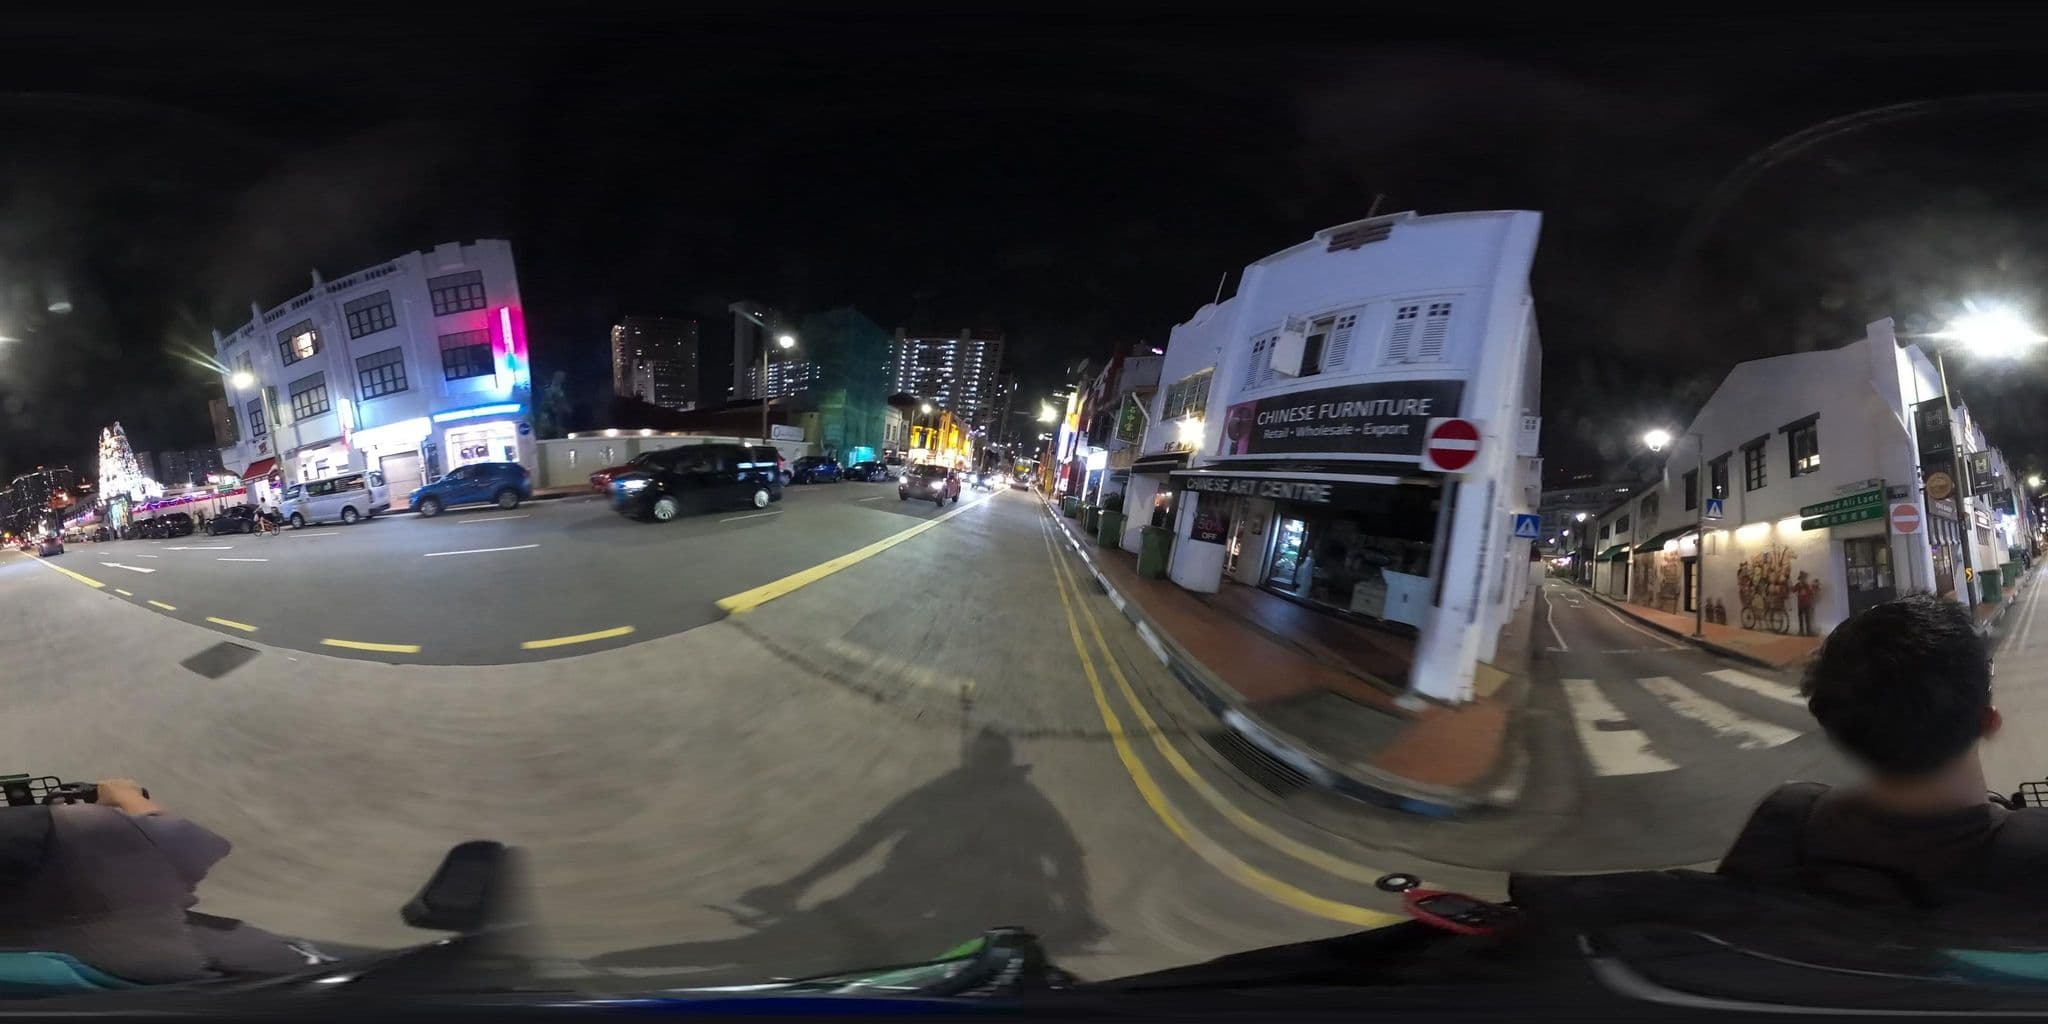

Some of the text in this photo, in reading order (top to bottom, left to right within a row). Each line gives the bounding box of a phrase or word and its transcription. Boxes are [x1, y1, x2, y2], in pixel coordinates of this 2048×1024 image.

[1257, 398, 1432, 425] CHINESE FURNITURE
[1263, 423, 1409, 439] Retail Wholesale Export
[1186, 478, 1332, 502] CHINESE ART CENTRE
